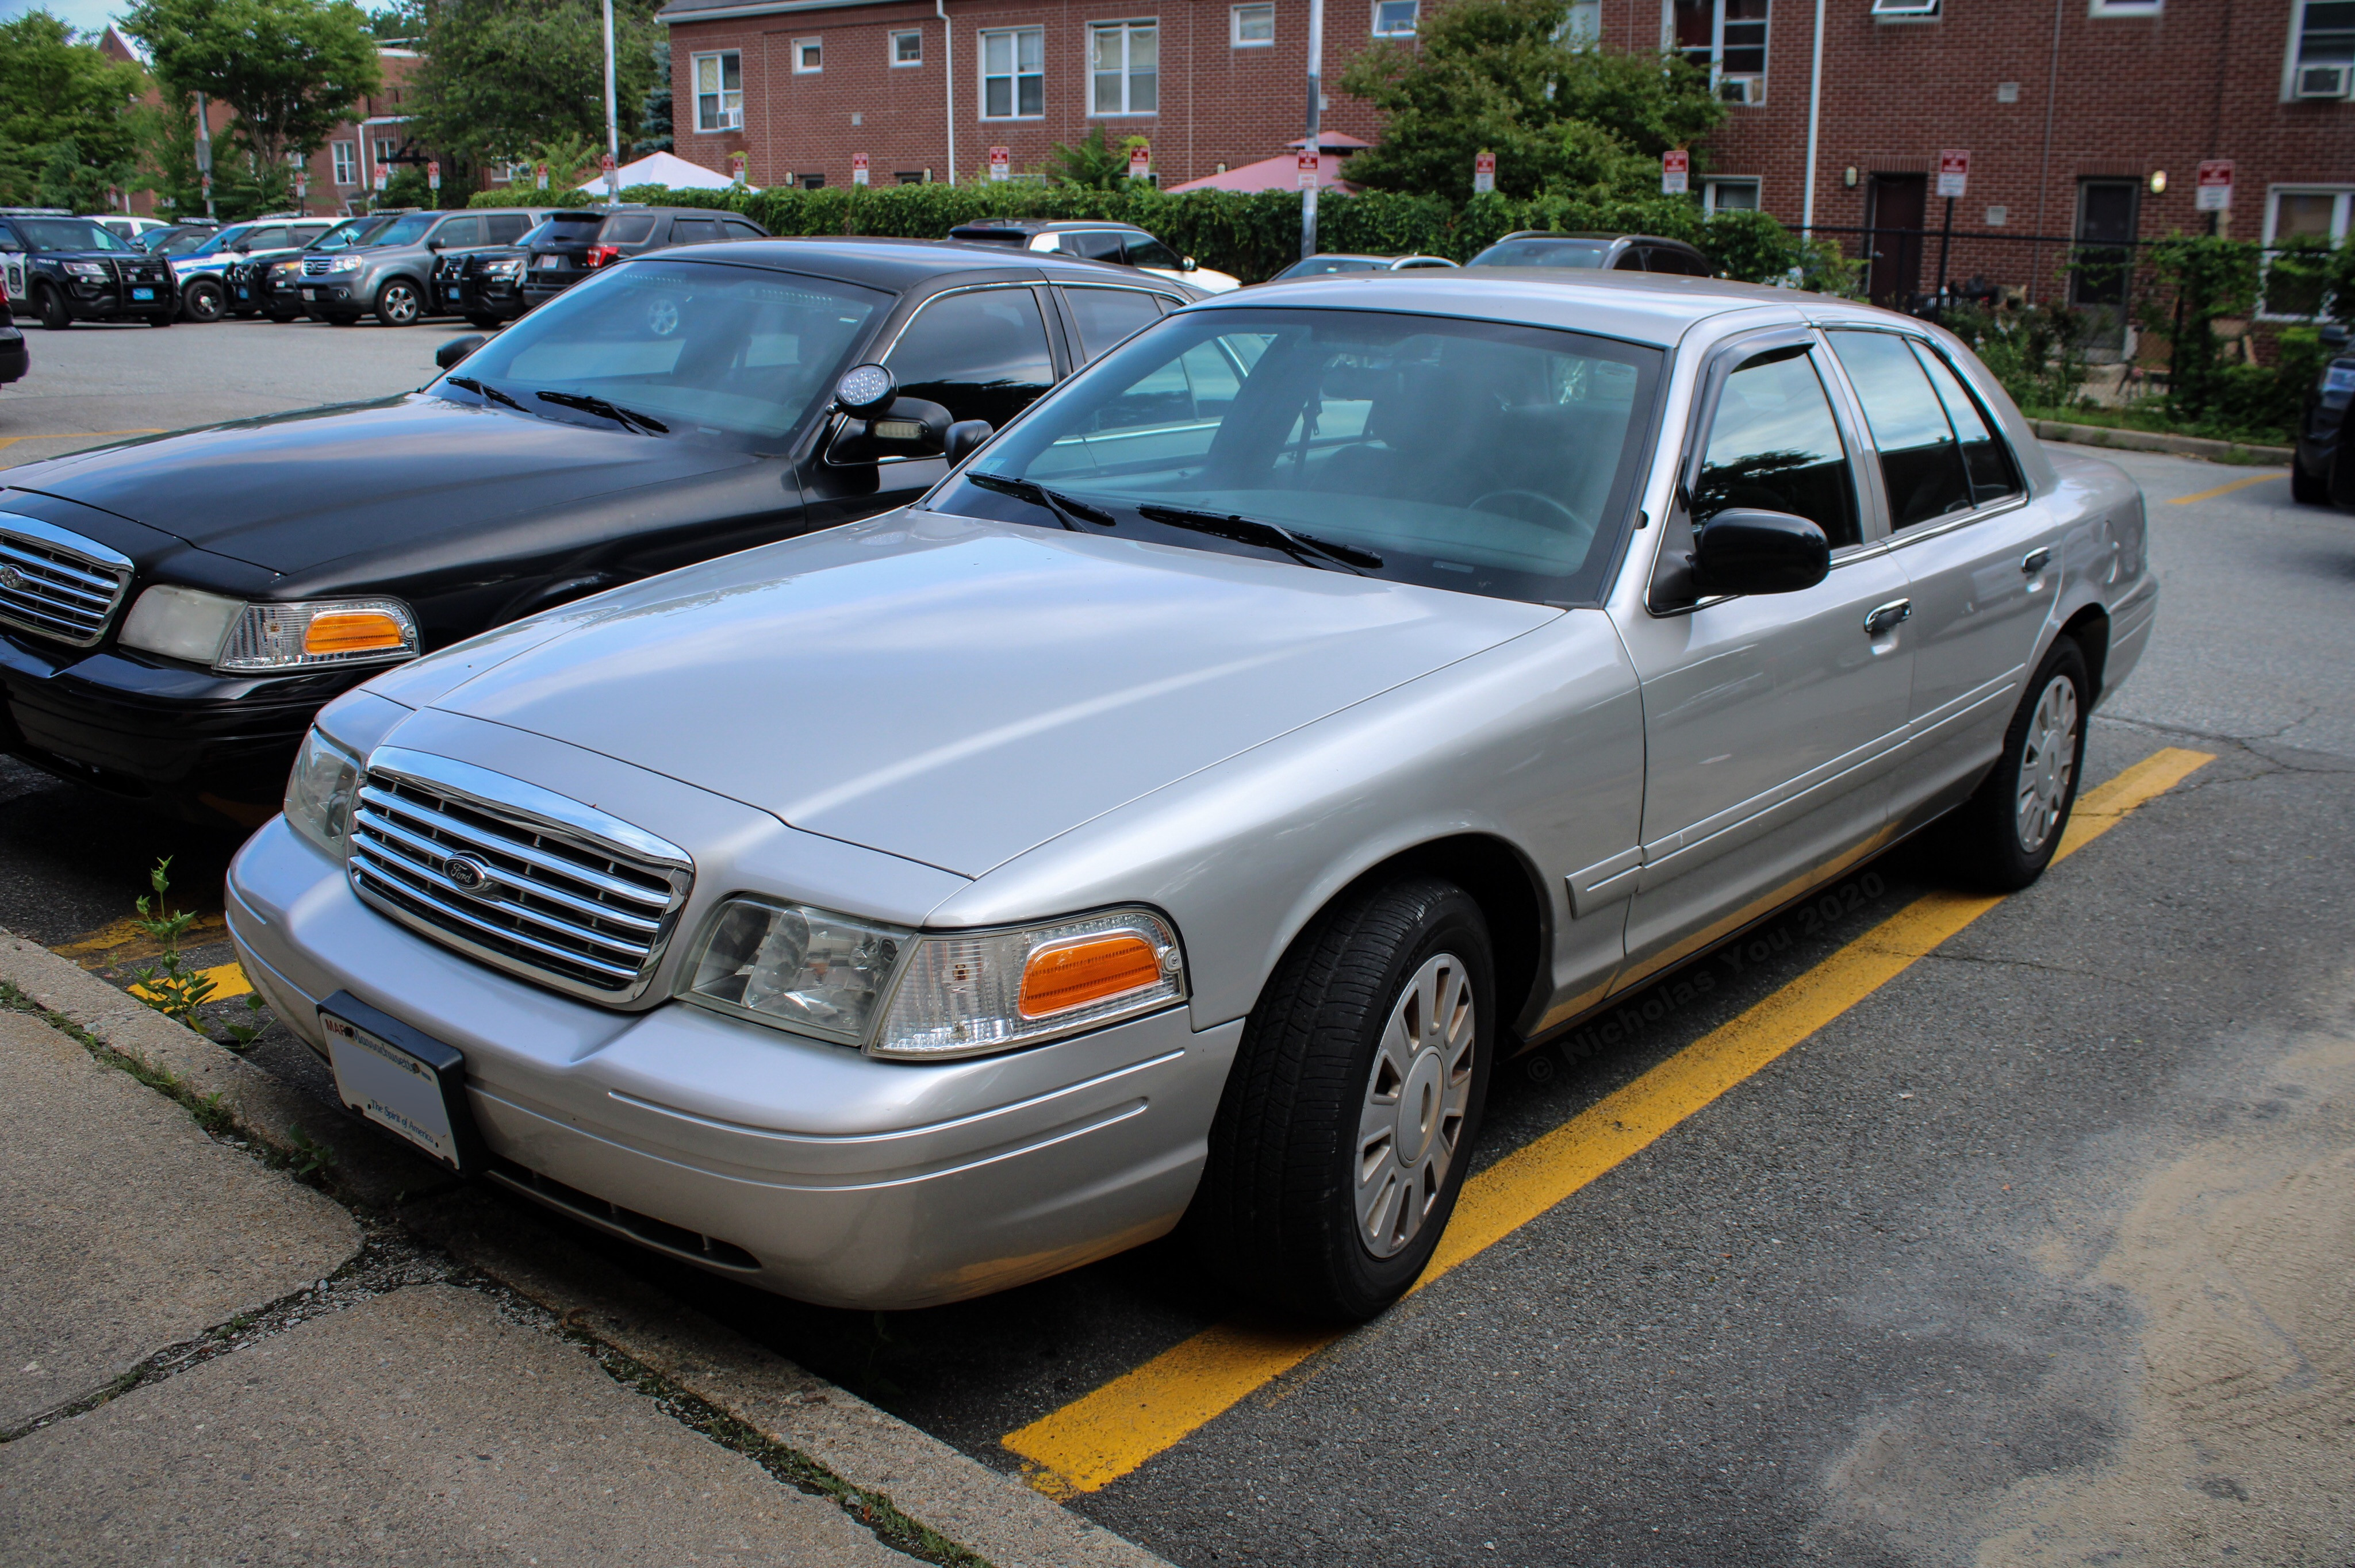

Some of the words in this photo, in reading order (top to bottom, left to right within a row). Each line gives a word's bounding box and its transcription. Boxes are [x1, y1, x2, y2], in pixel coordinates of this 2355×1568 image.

[451, 863, 472, 883] Ford
[371, 1099, 383, 1113] The
[385, 1106, 400, 1123] Spirit
[402, 1118, 408, 1128] of
[409, 1121, 434, 1143] America
